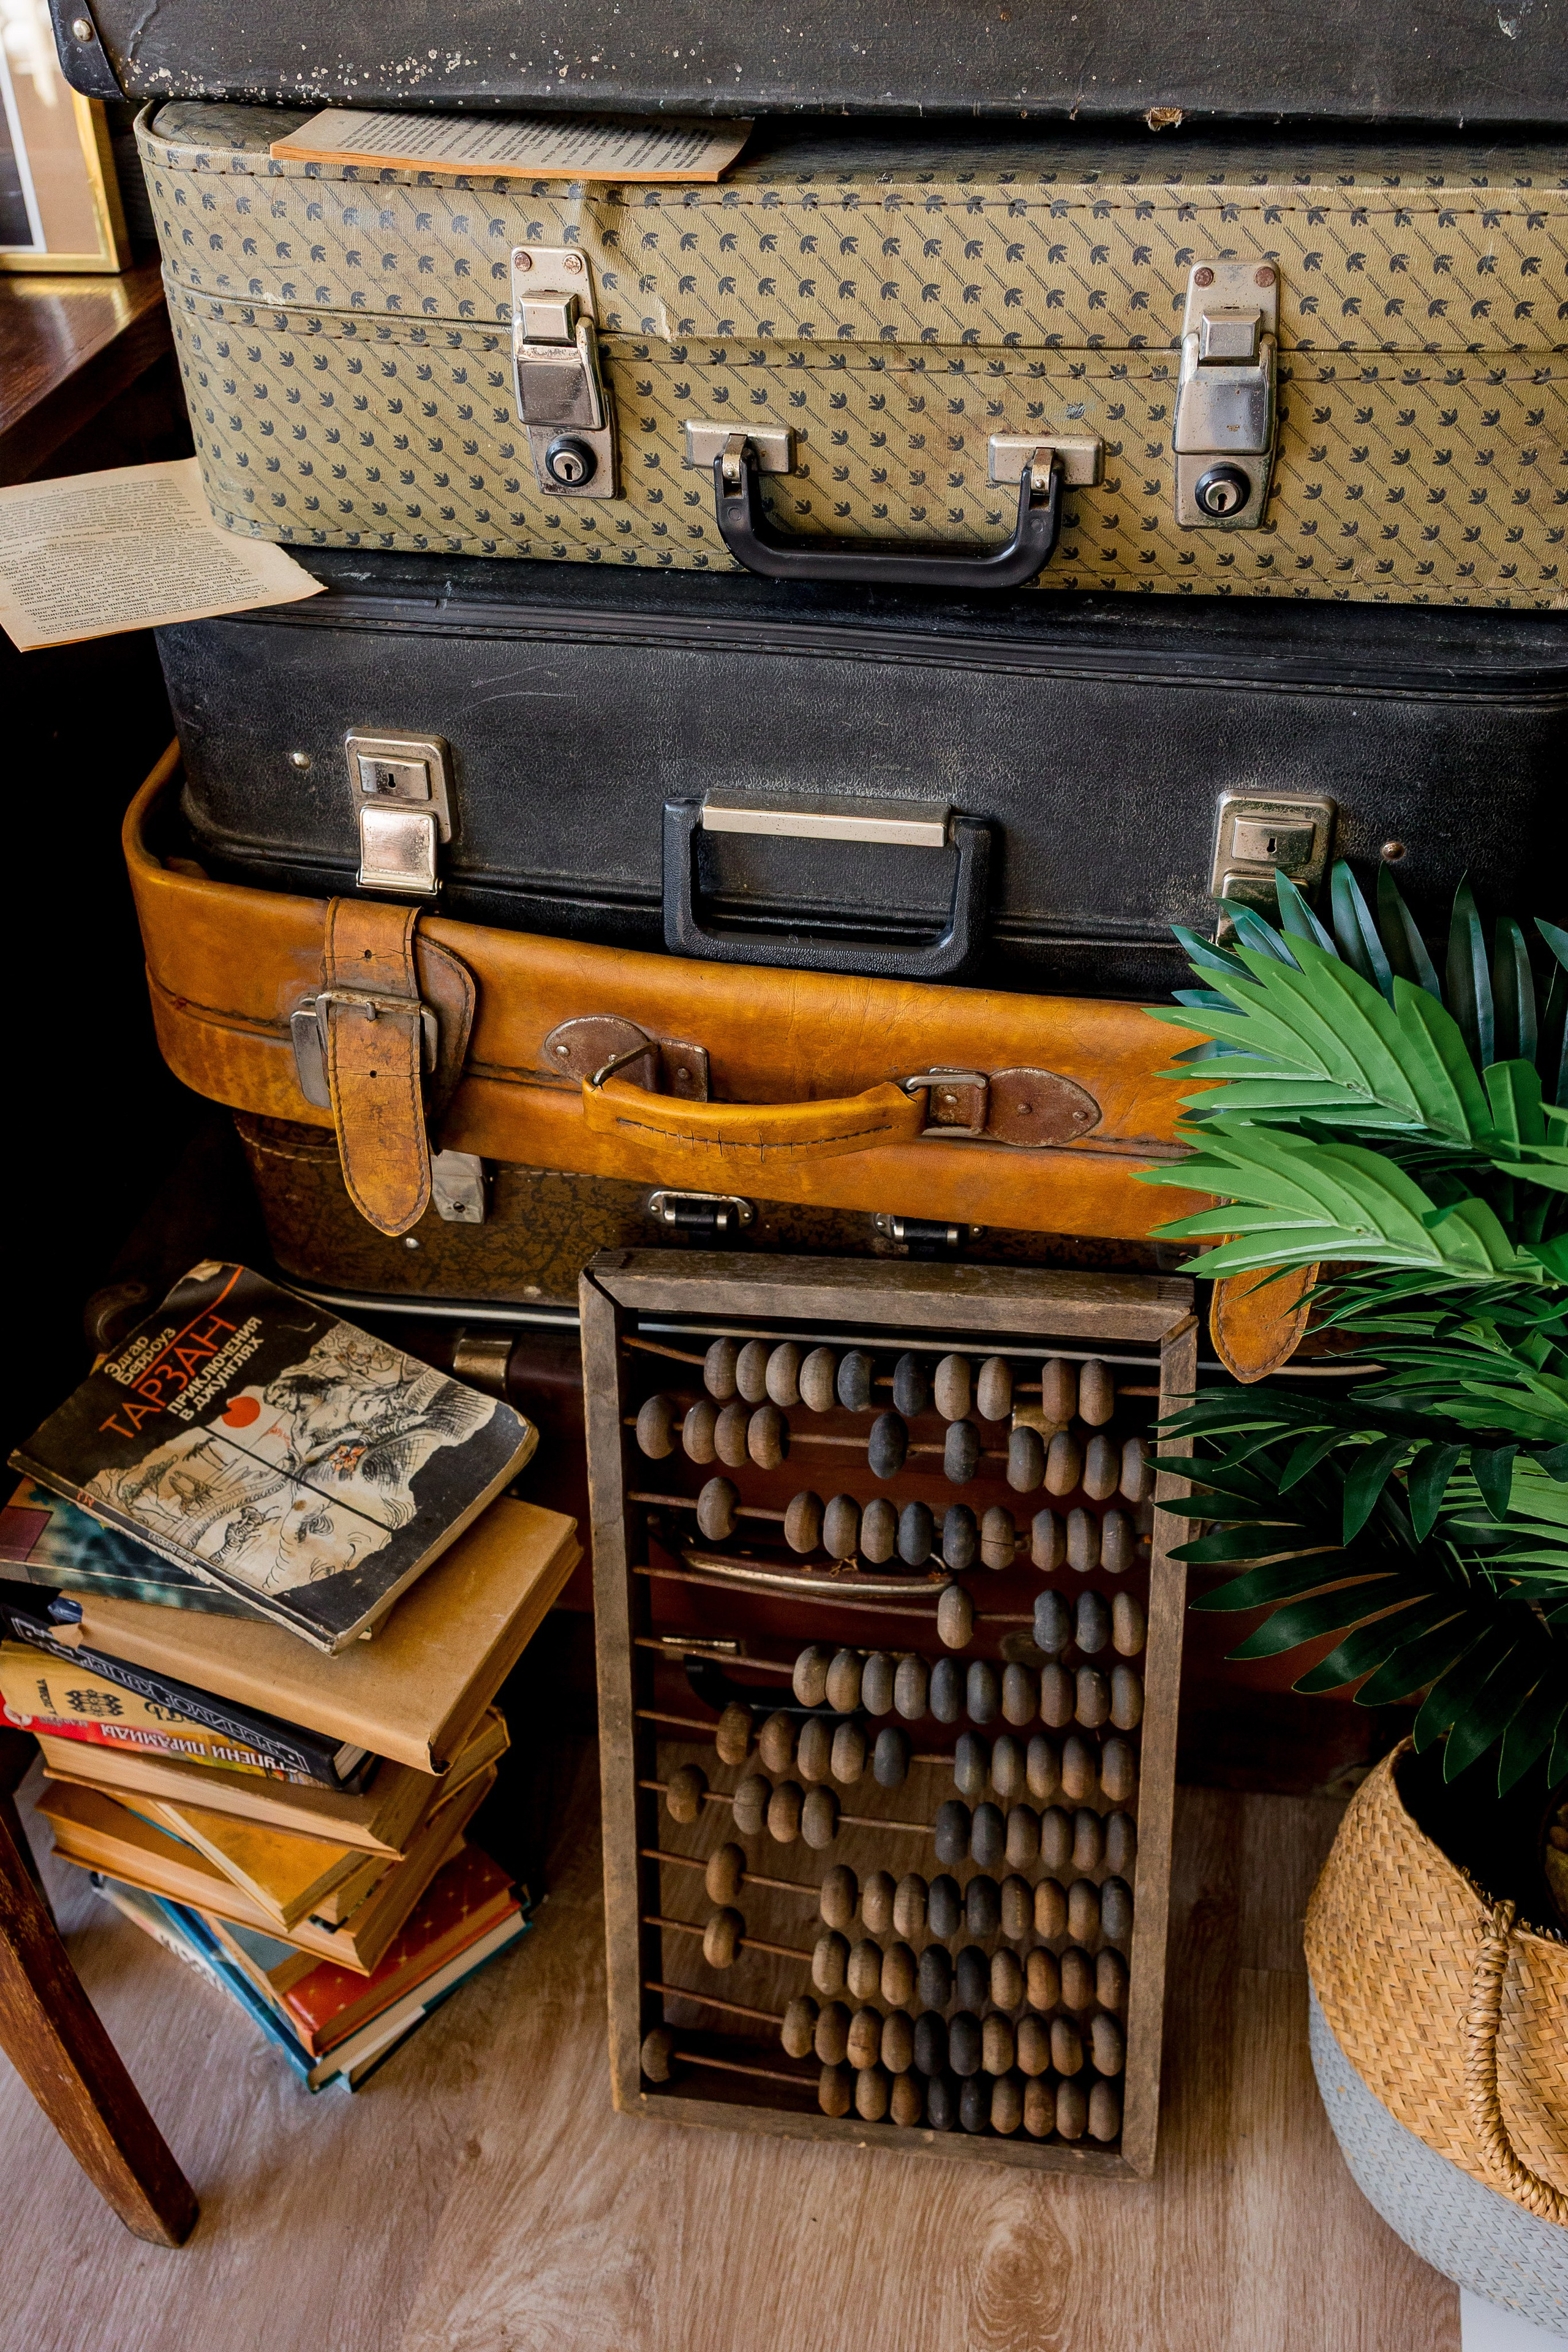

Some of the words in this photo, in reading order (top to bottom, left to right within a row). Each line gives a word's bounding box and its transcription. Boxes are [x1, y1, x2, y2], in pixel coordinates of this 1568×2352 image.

[99, 1315, 238, 1438] ТАРЗАН
[104, 1336, 149, 1377] Эдгар
[116, 1327, 176, 1385] Берроуз
[167, 1316, 263, 1414] ПРИКЛЮЧЕНИЯ
[179, 1409, 195, 1421] В
[193, 1336, 265, 1411] ДЖУНГЛЯХ
[100, 1724, 208, 1756] ПИРАМИДЫ
[167, 1694, 280, 1755] ФЕНИМОР
